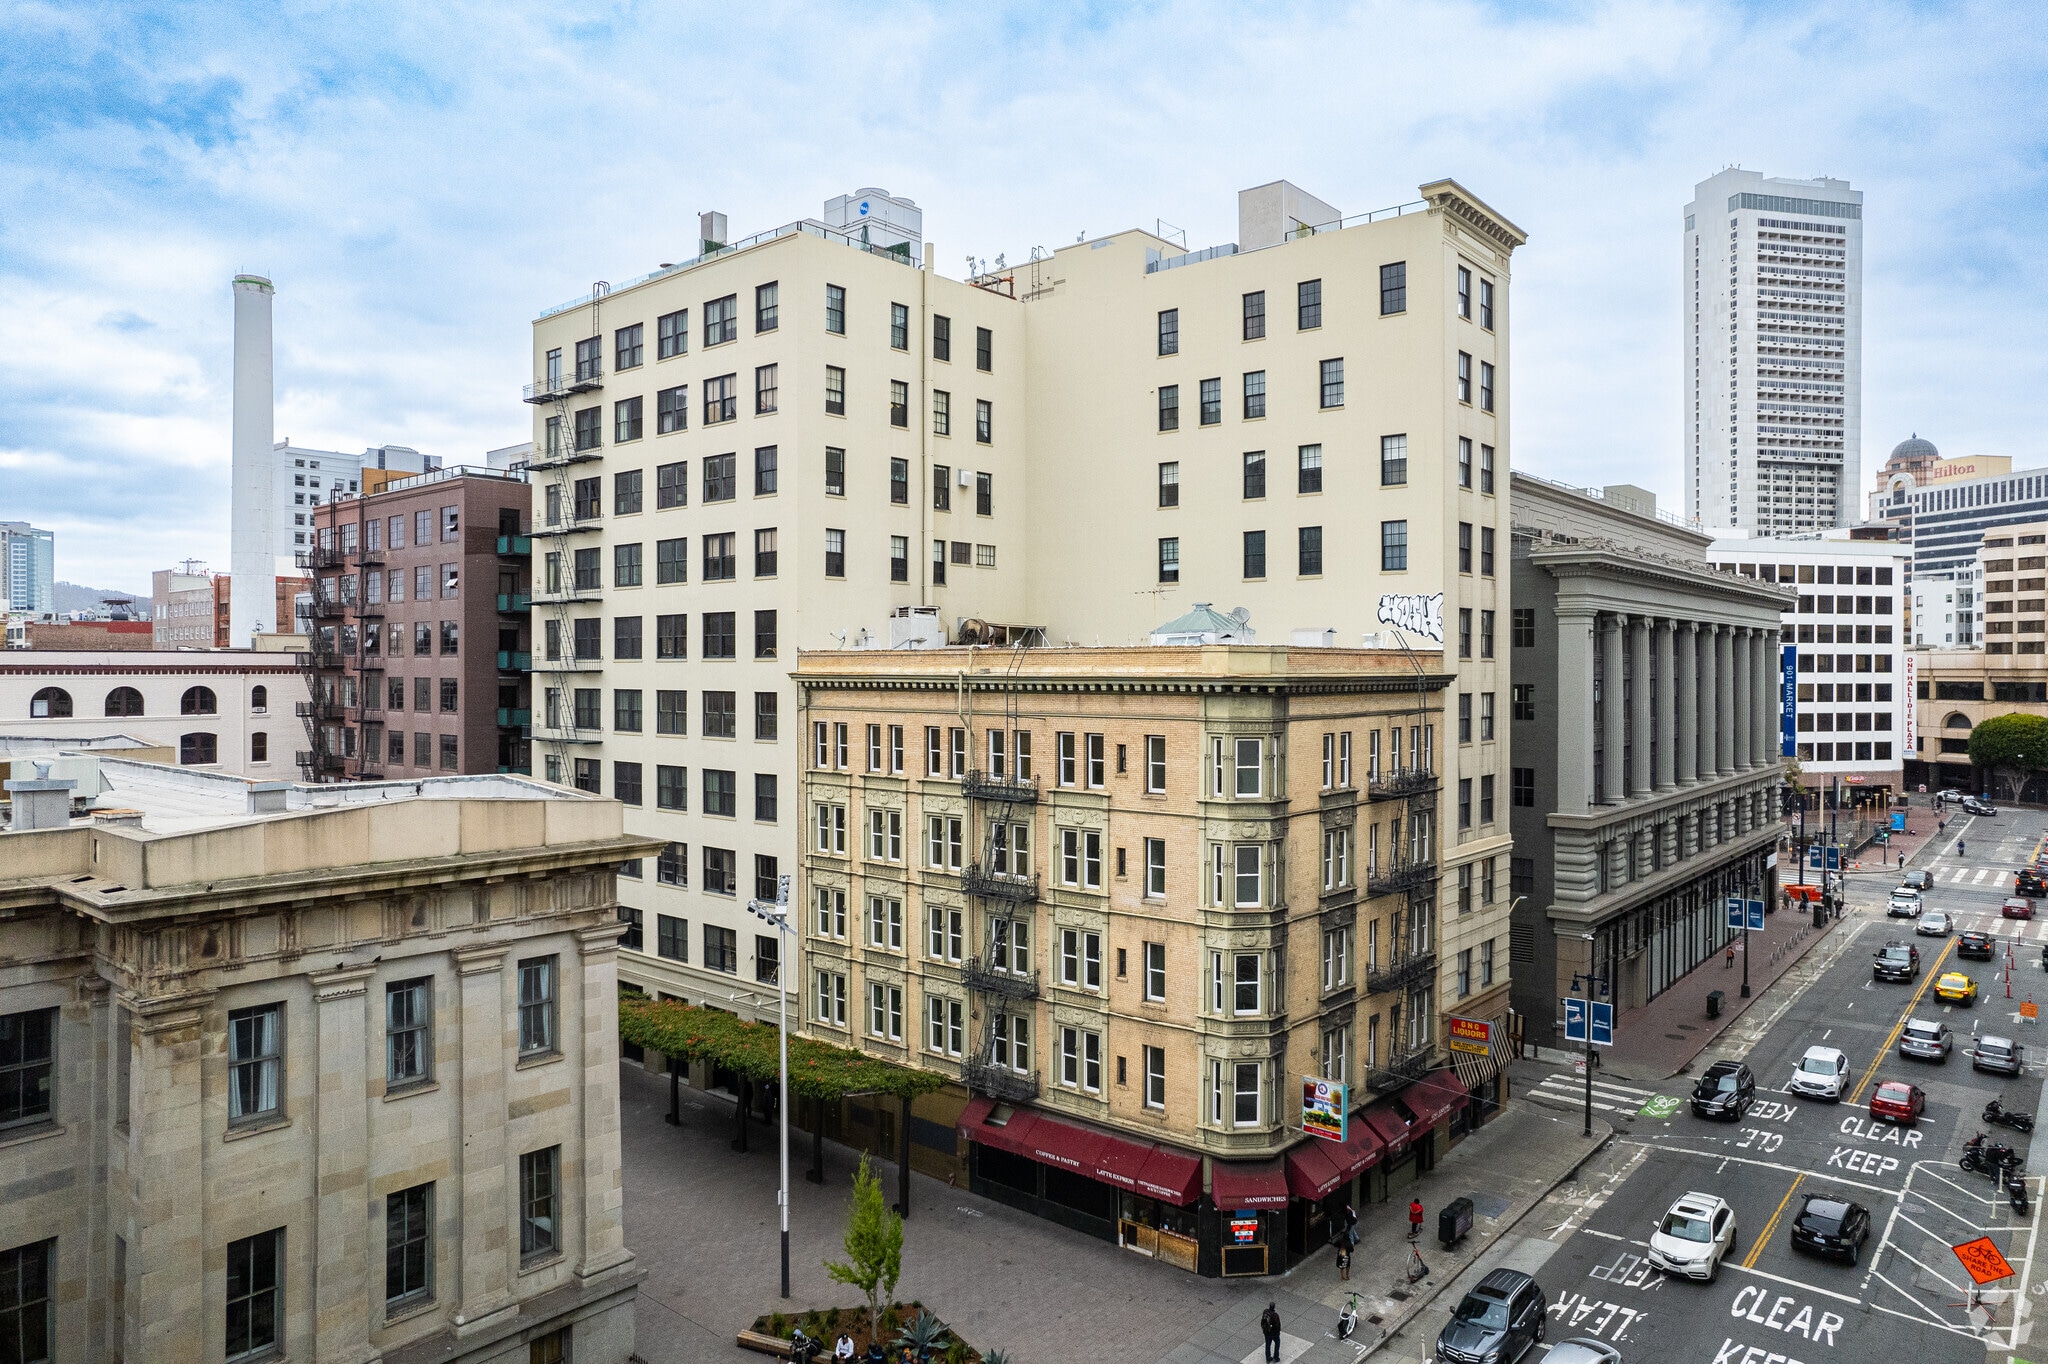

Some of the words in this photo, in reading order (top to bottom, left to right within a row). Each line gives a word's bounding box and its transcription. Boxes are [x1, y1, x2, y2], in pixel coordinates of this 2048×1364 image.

[1933, 464, 1975, 478] Hilton
[1453, 1026, 1486, 1039] LIQUORS
[1840, 1116, 1924, 1149] CLEAR
[1035, 1149, 1055, 1160] COFFEE
[1061, 1157, 1080, 1167] PASTRY
[1826, 1146, 1900, 1176] KEEP
[1096, 1168, 1113, 1179] LATTE
[1113, 1173, 1135, 1185] EXPRESS
[1244, 1196, 1287, 1204] SANDWICHES
[1962, 1253, 1987, 1269] SHARE
[1989, 1264, 2004, 1275] THE
[1970, 1263, 1992, 1277] ROAD
[1547, 1290, 1649, 1344] LEAR
[1731, 1285, 1844, 1347] CLEAR
